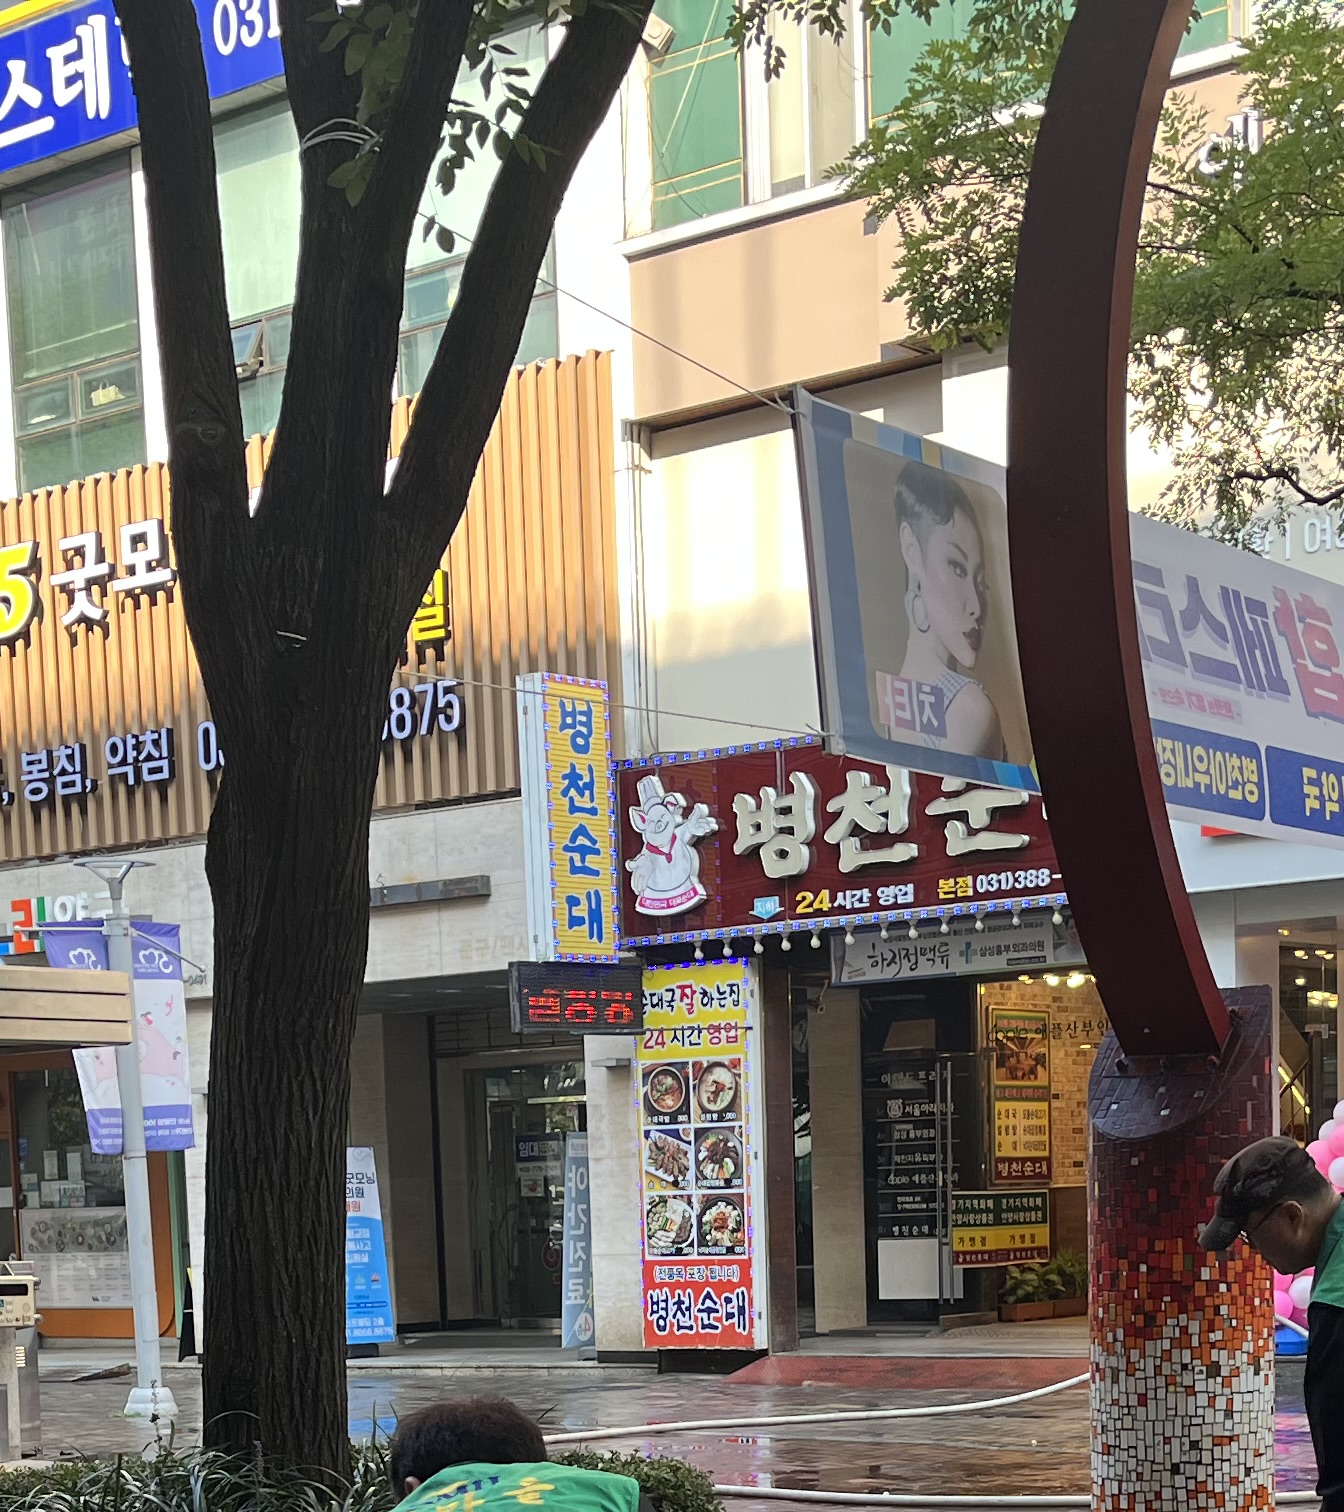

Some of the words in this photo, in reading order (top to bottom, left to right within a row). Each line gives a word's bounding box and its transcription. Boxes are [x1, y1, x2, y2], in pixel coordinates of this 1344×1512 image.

[105, 726, 170, 788] 약침
[558, 698, 605, 946] 병천순대
[733, 764, 1031, 879] 병천순
[876, 883, 914, 906] 영업
[937, 874, 974, 900] 본점
[866, 941, 951, 978] 하지정맥류
[643, 1027, 667, 1049] 24
[670, 1025, 703, 1048] 시간
[706, 1021, 739, 1046] 영업
[997, 1161, 1048, 1177] 병천순대
[957, 1235, 987, 1248] 가맹점
[686, 1266, 706, 1281] 포장
[648, 1287, 748, 1333] 병천순대
